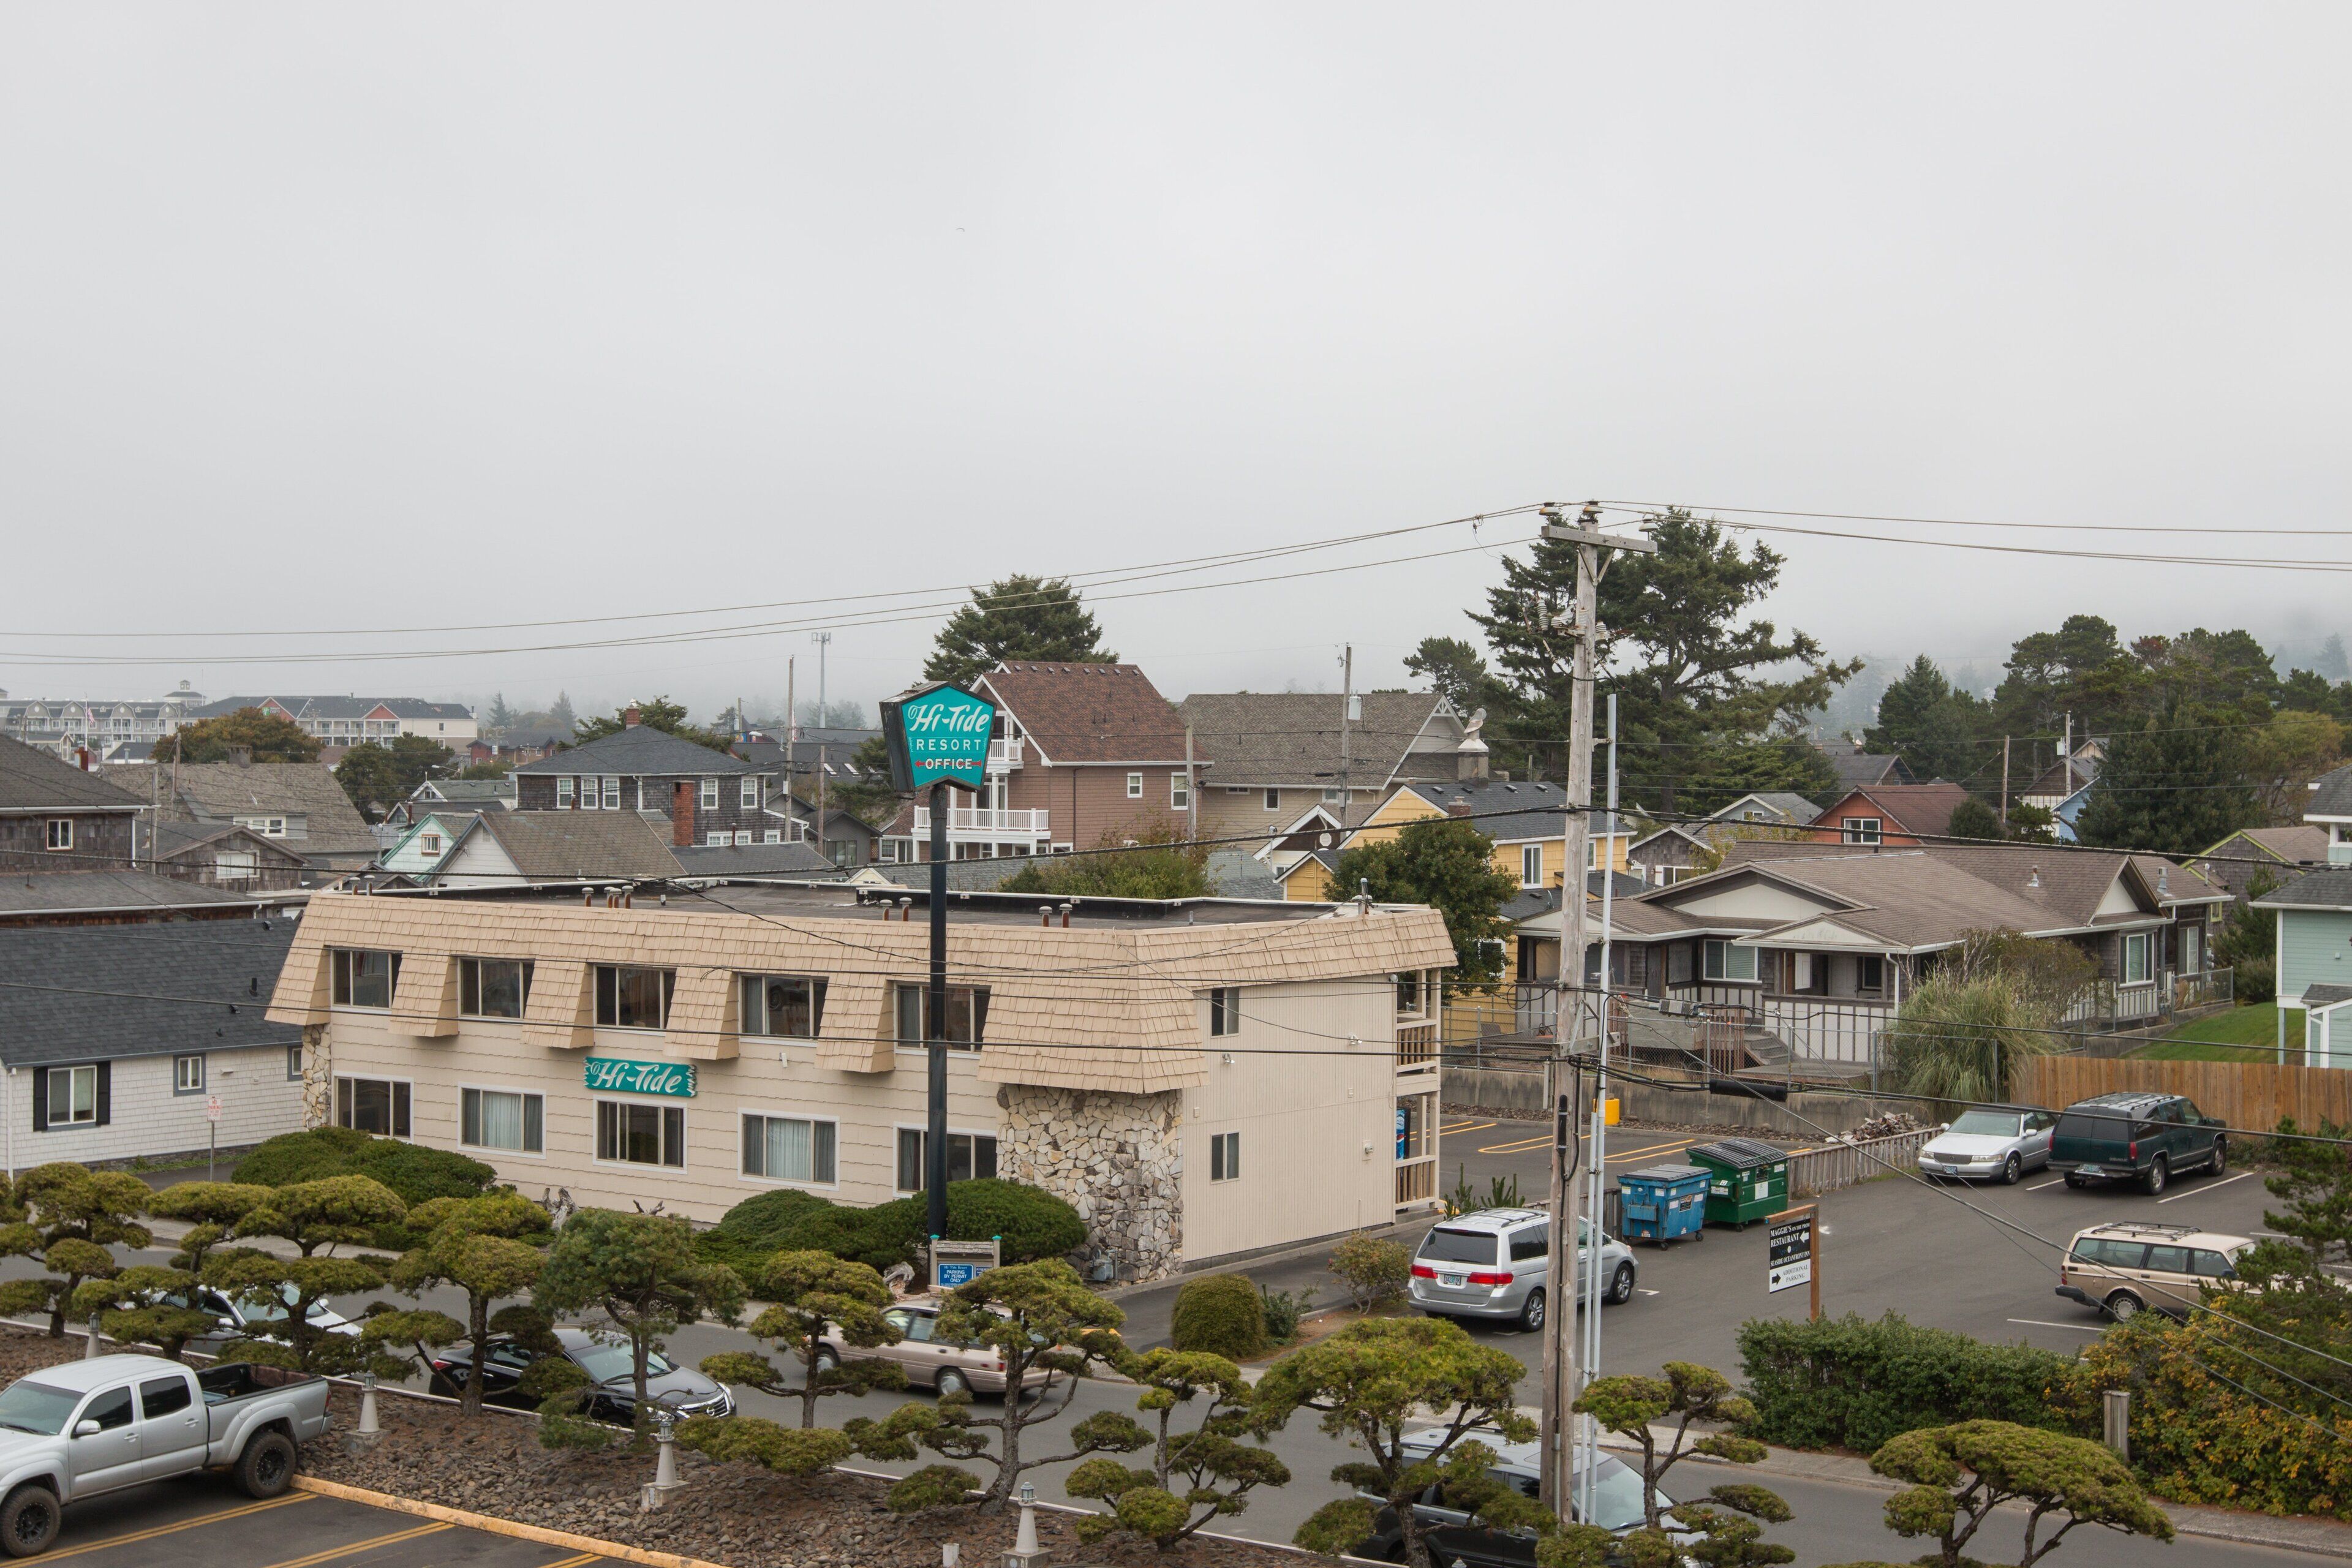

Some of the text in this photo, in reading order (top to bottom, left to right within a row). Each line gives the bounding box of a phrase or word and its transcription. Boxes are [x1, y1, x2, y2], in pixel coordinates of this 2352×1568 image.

[908, 704, 990, 732] Hi-Tide
[916, 739, 981, 750] RESORT
[925, 758, 973, 769] OFFICE
[590, 1061, 682, 1093] Hi-Tide
[1771, 1225, 1792, 1237] MAGGIE'S
[1771, 1232, 1799, 1248] RESTAURANT
[1771, 1257, 1783, 1267] SEASIDE
[1783, 1252, 1804, 1263] OCEANFRONT
[1782, 1265, 1808, 1276] ADDITIONAL
[1785, 1273, 1805, 1283] PARKING
